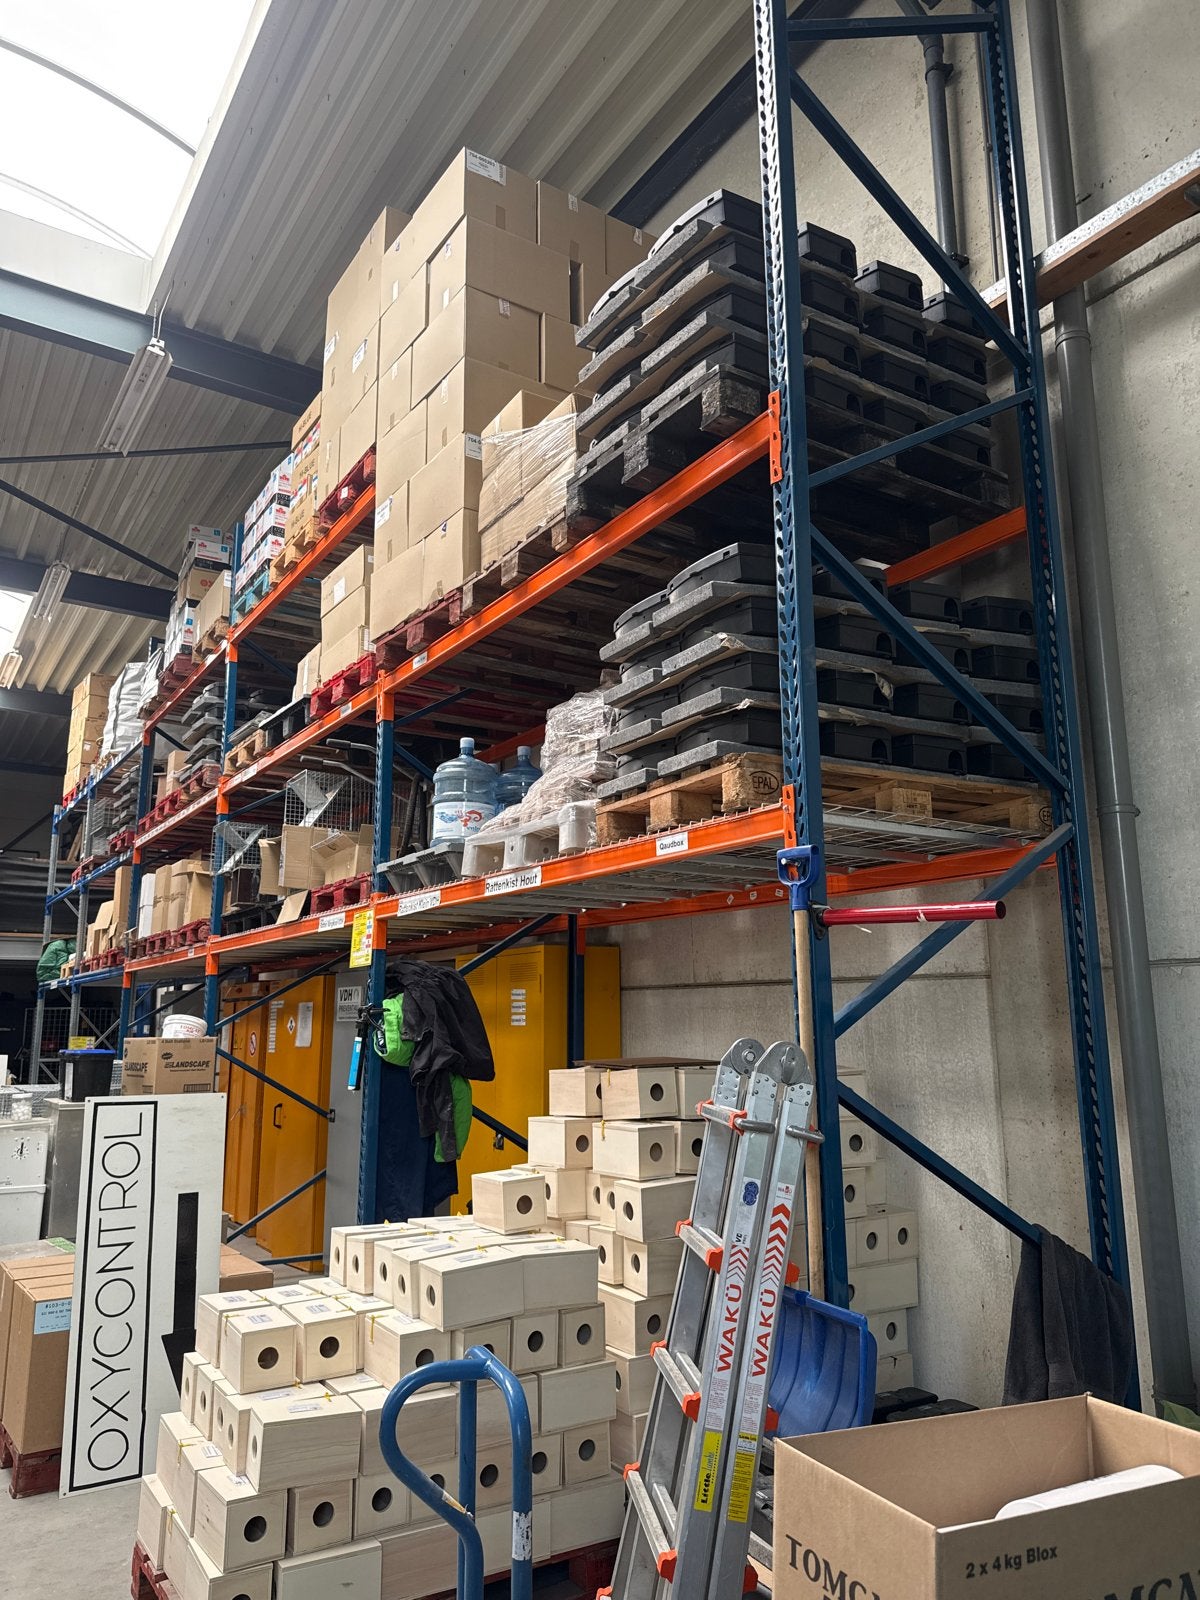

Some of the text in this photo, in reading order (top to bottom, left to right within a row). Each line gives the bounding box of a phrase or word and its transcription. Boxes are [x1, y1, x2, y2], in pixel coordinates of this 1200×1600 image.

[752, 775, 775, 790] EPAL
[486, 873, 538, 893] Rattenkist Hout
[339, 988, 353, 1002] VDH
[171, 1060, 211, 1069] LANDSCAPE
[87, 1111, 143, 1472] OXYCONTROL
[717, 1284, 742, 1373] WAKÜ
[752, 1288, 777, 1377] WAKÜ
[700, 1472, 712, 1504] Little
[785, 1533, 881, 1600] TOMC
[965, 1546, 1058, 1579] 2 x 4 kg Blox
